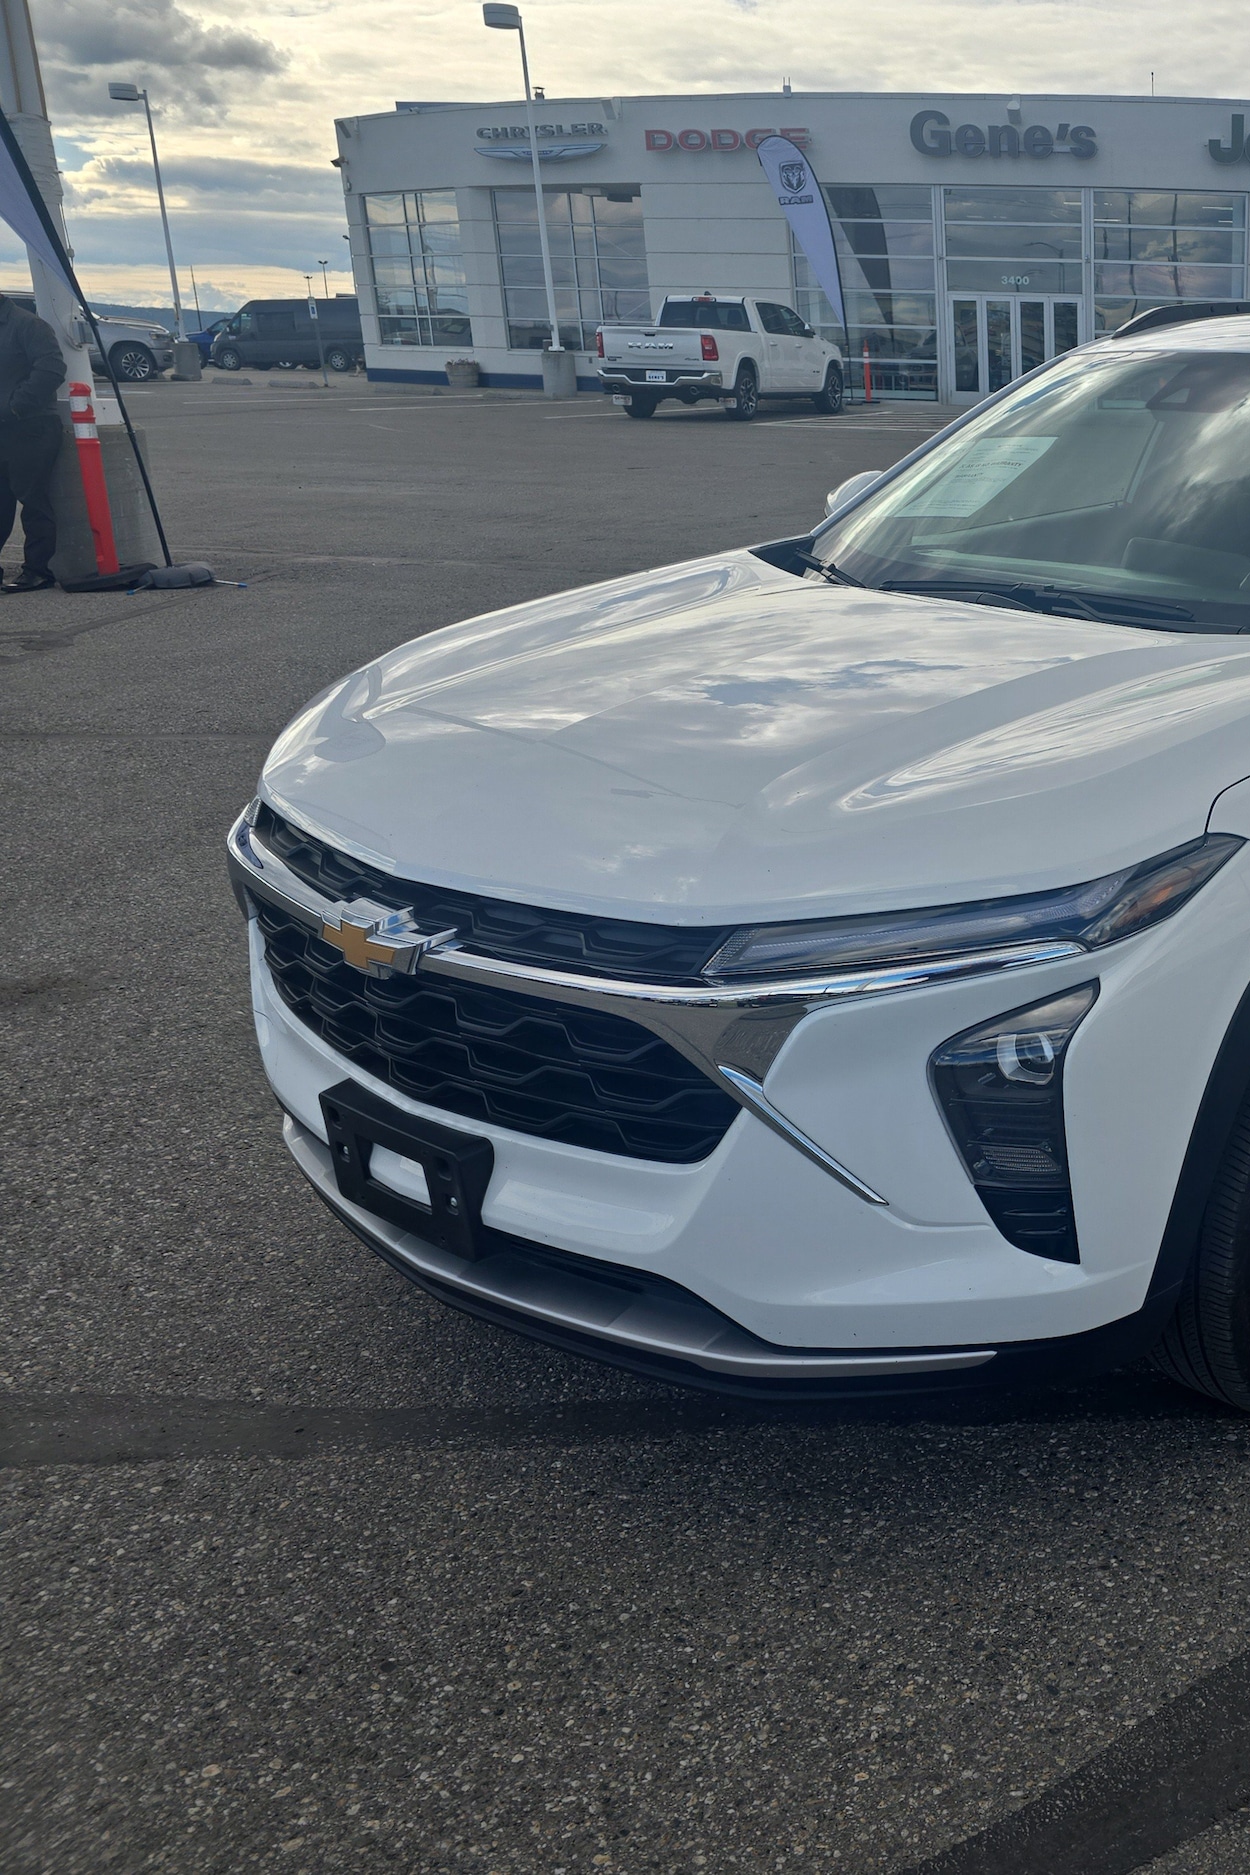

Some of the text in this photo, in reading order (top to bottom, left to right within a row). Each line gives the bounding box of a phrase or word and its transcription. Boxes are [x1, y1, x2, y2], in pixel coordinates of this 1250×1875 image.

[644, 127, 810, 151] DODGE
[909, 109, 1098, 160] Gene's
[778, 195, 814, 206] RAM
[1001, 276, 1030, 285] 3400
[627, 341, 674, 350] RAM
